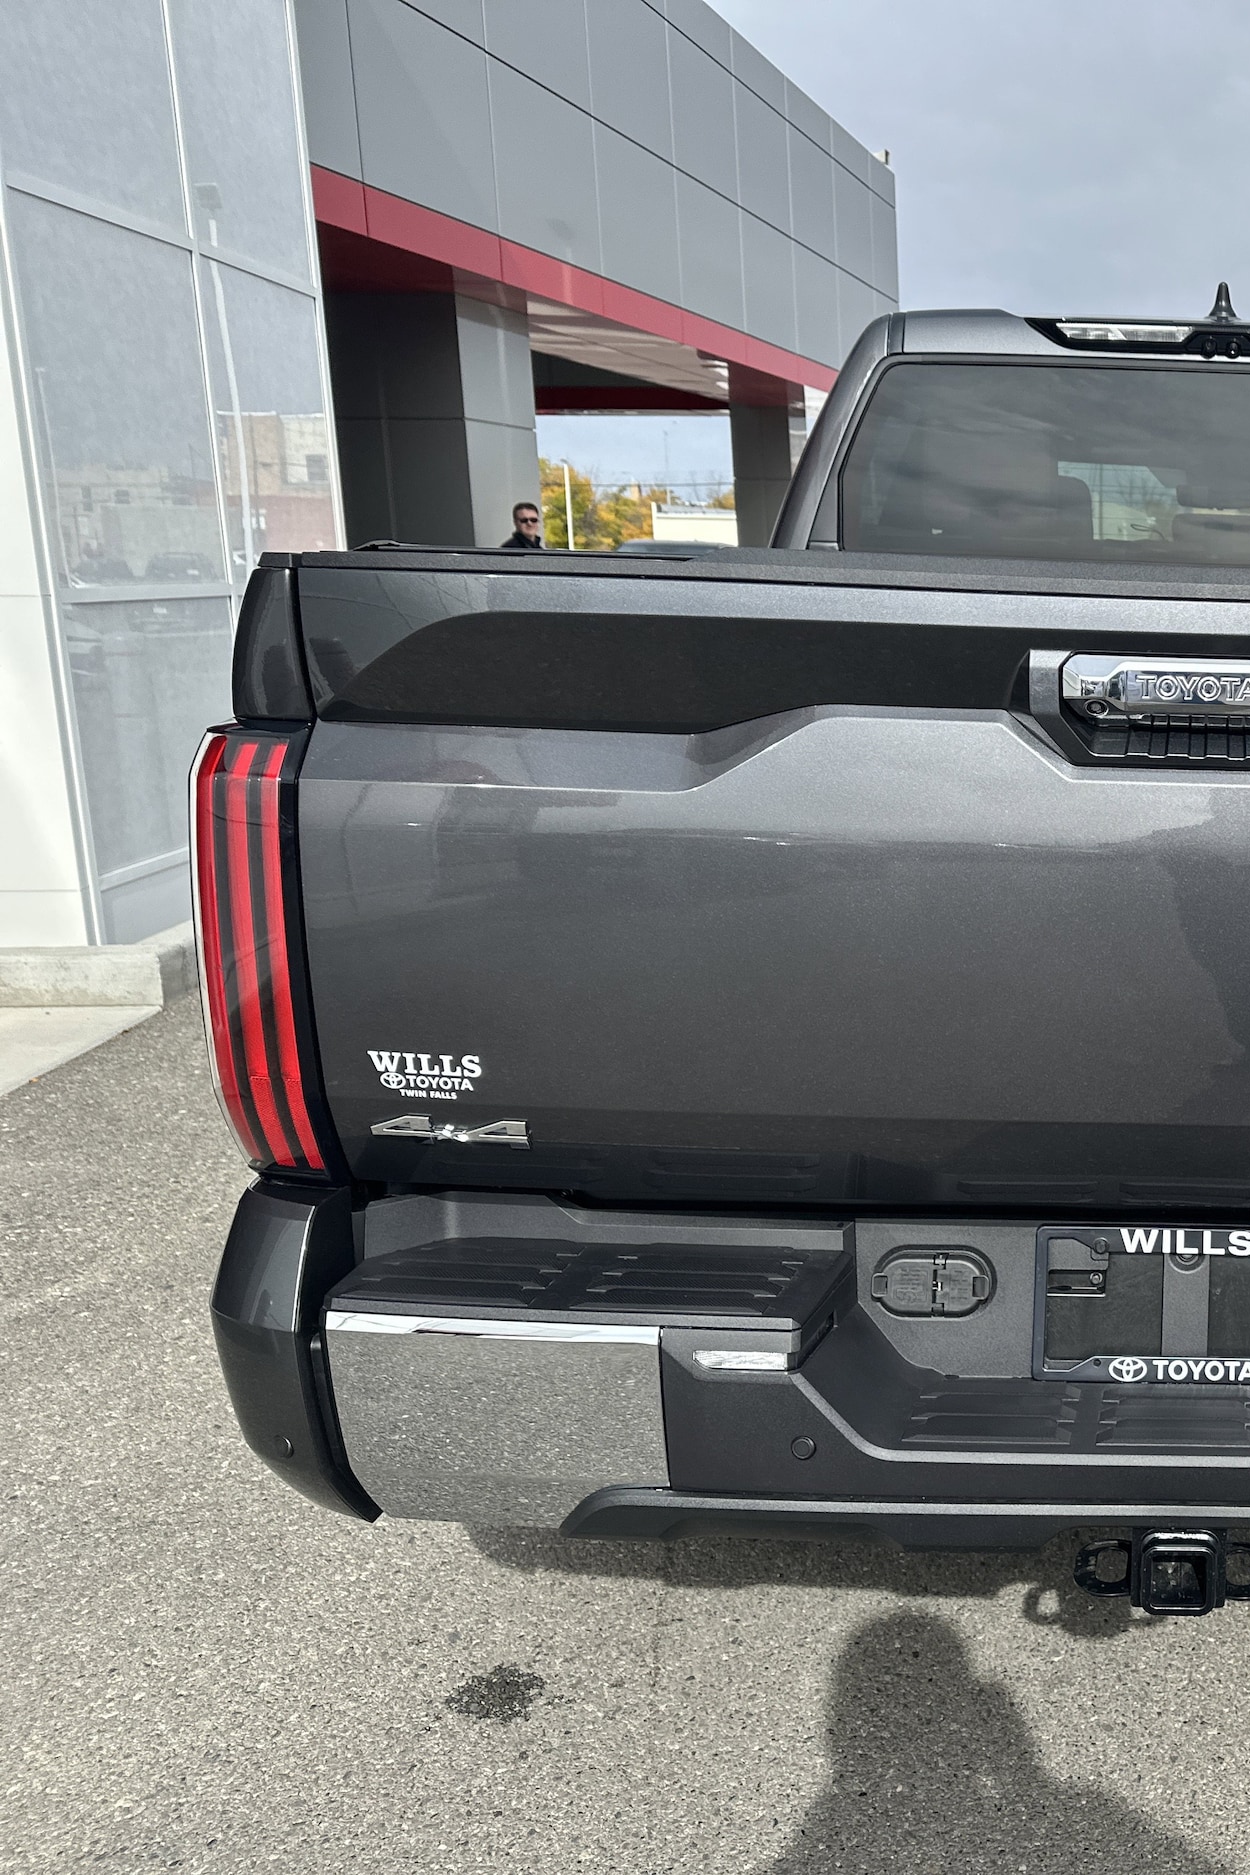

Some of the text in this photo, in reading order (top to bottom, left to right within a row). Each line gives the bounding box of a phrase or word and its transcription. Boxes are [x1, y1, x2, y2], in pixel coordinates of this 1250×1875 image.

[367, 1050, 482, 1078] WILLS
[406, 1075, 473, 1091] TOYOTA
[399, 1088, 458, 1100] TWIN FALLS
